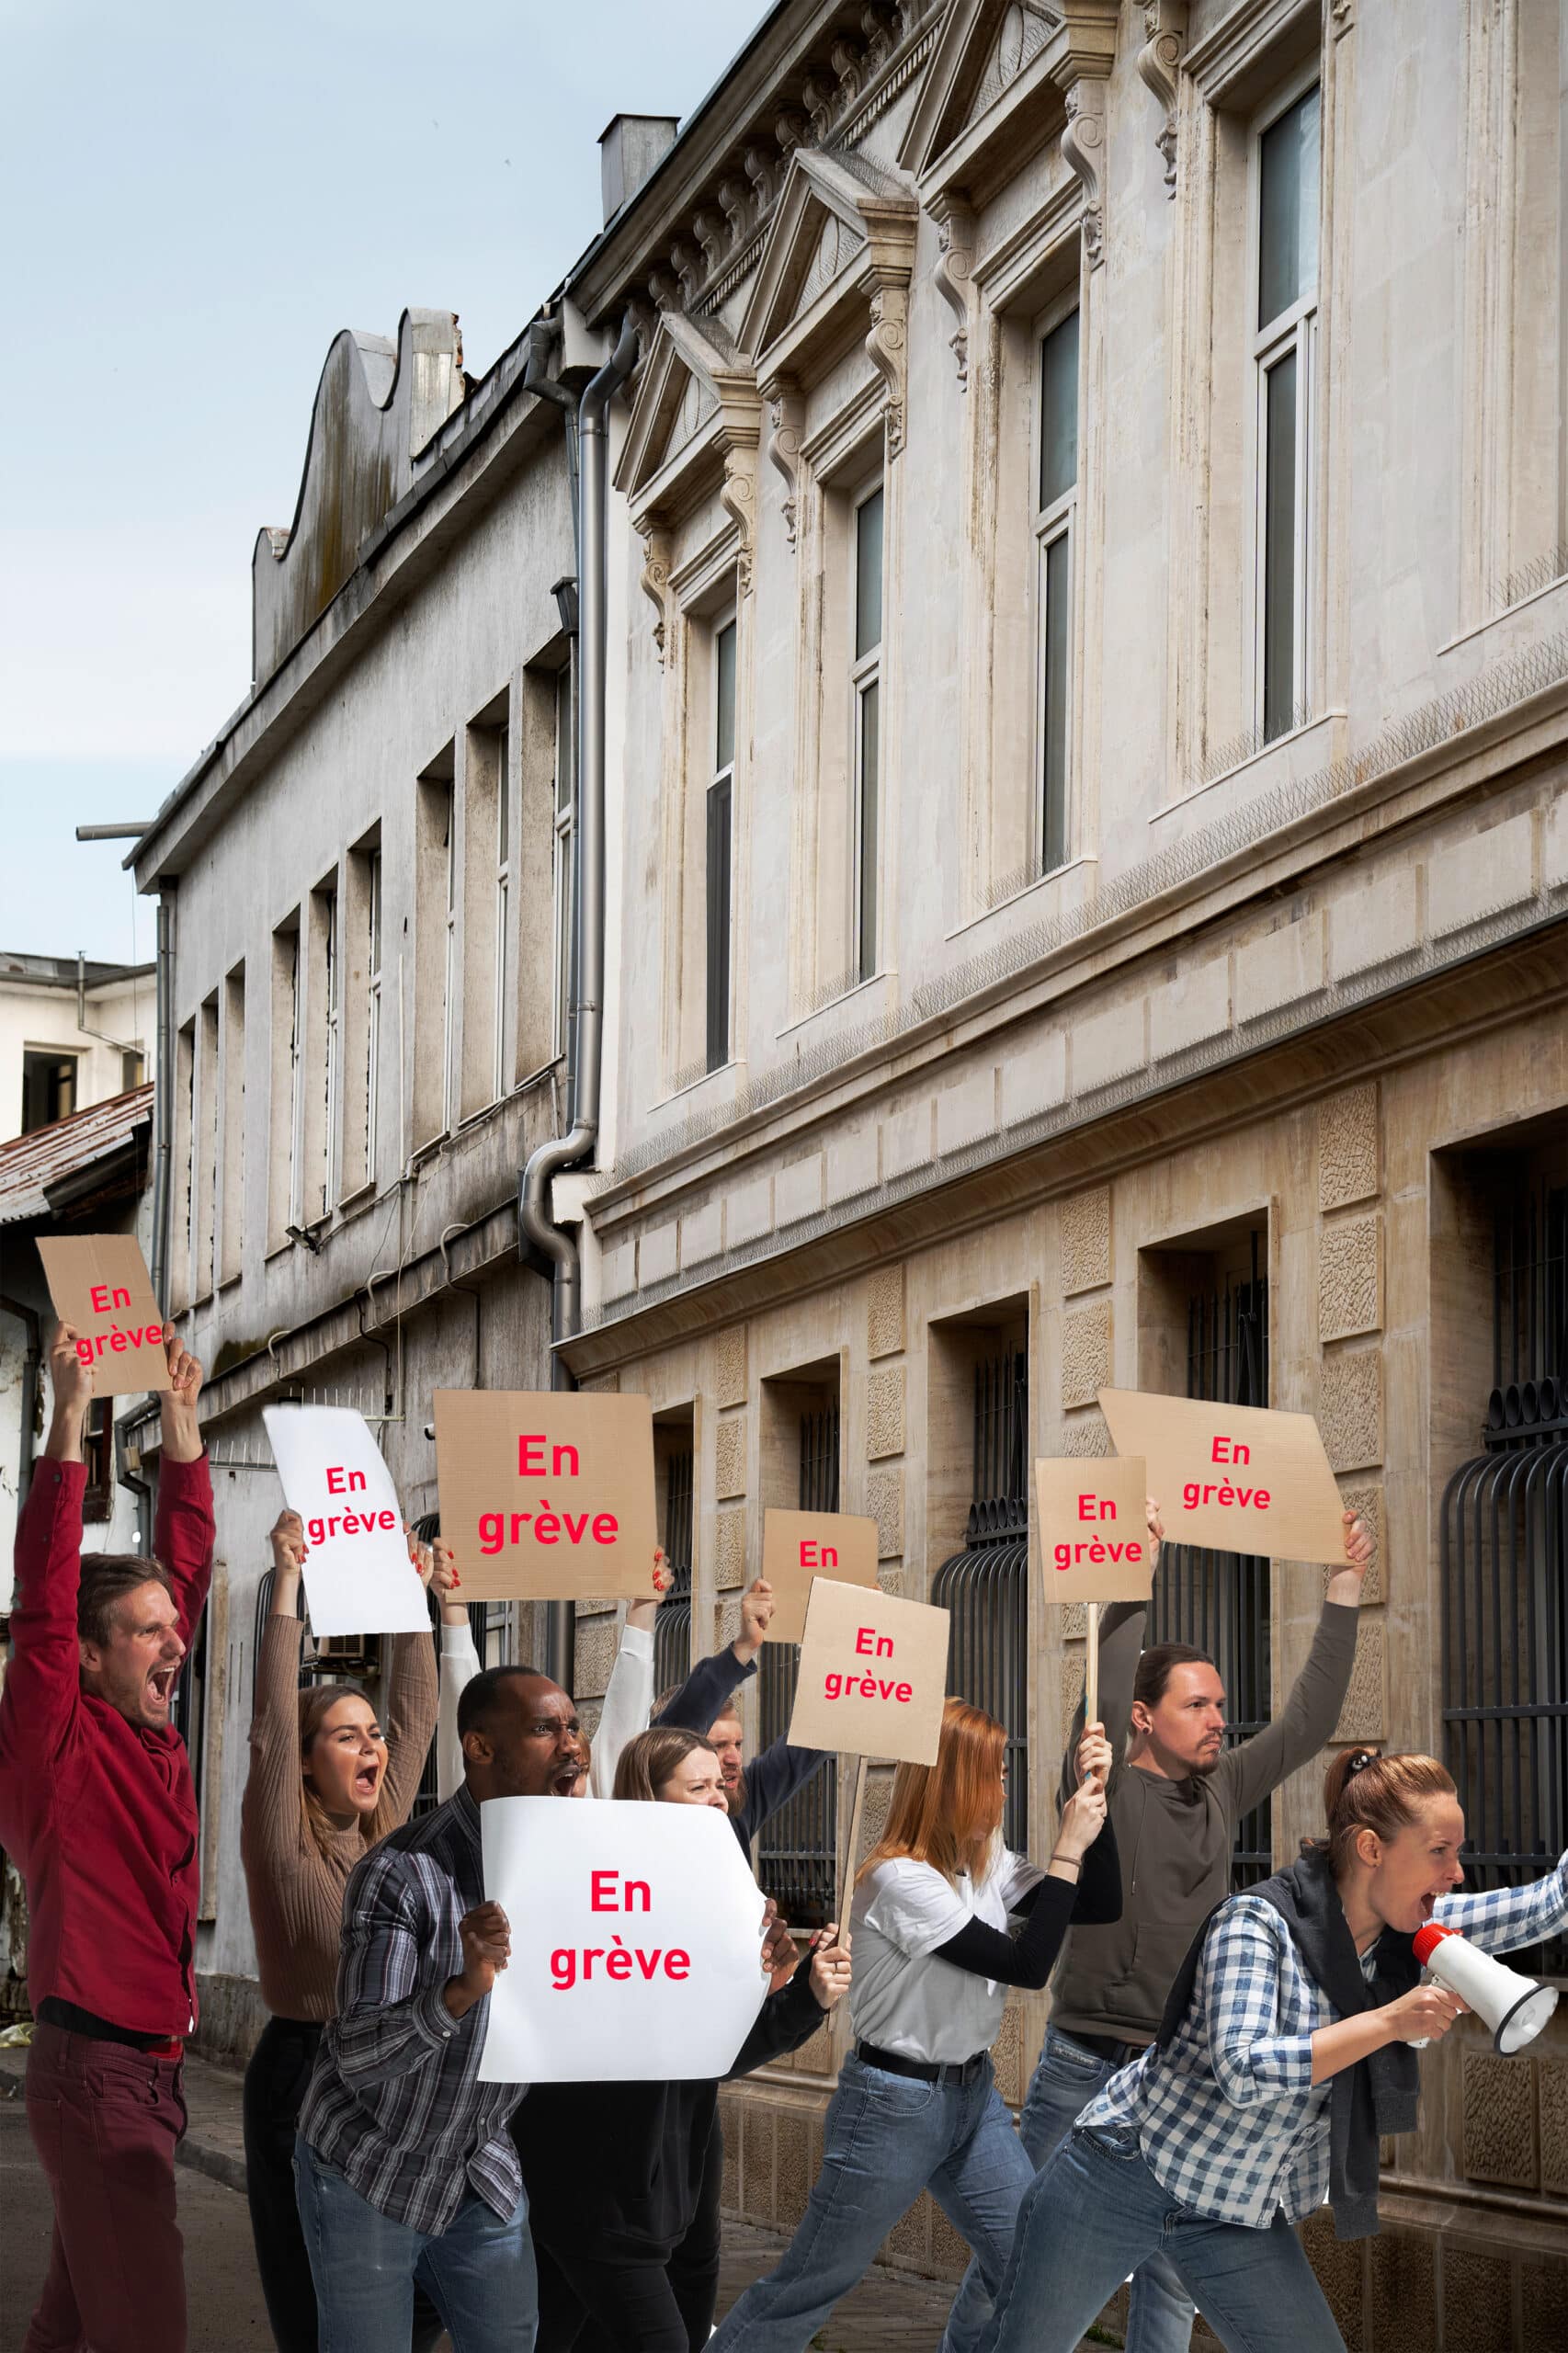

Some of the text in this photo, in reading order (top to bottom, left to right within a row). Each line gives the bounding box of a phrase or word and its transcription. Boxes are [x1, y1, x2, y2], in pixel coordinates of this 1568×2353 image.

[89, 1285, 131, 1313] En
[75, 1324, 164, 1366] grève
[518, 1435, 581, 1476] En
[1211, 1436, 1251, 1465] En
[326, 1467, 367, 1495] En
[1183, 1477, 1271, 1510] grève
[308, 1506, 396, 1545] grève
[1078, 1495, 1117, 1522] En
[479, 1500, 619, 1555] grève
[800, 1540, 839, 1568] En
[1054, 1534, 1142, 1571] grève
[856, 1628, 894, 1657] En
[824, 1668, 914, 1703] grève
[592, 1870, 652, 1912] En
[551, 1935, 691, 1991] grève
